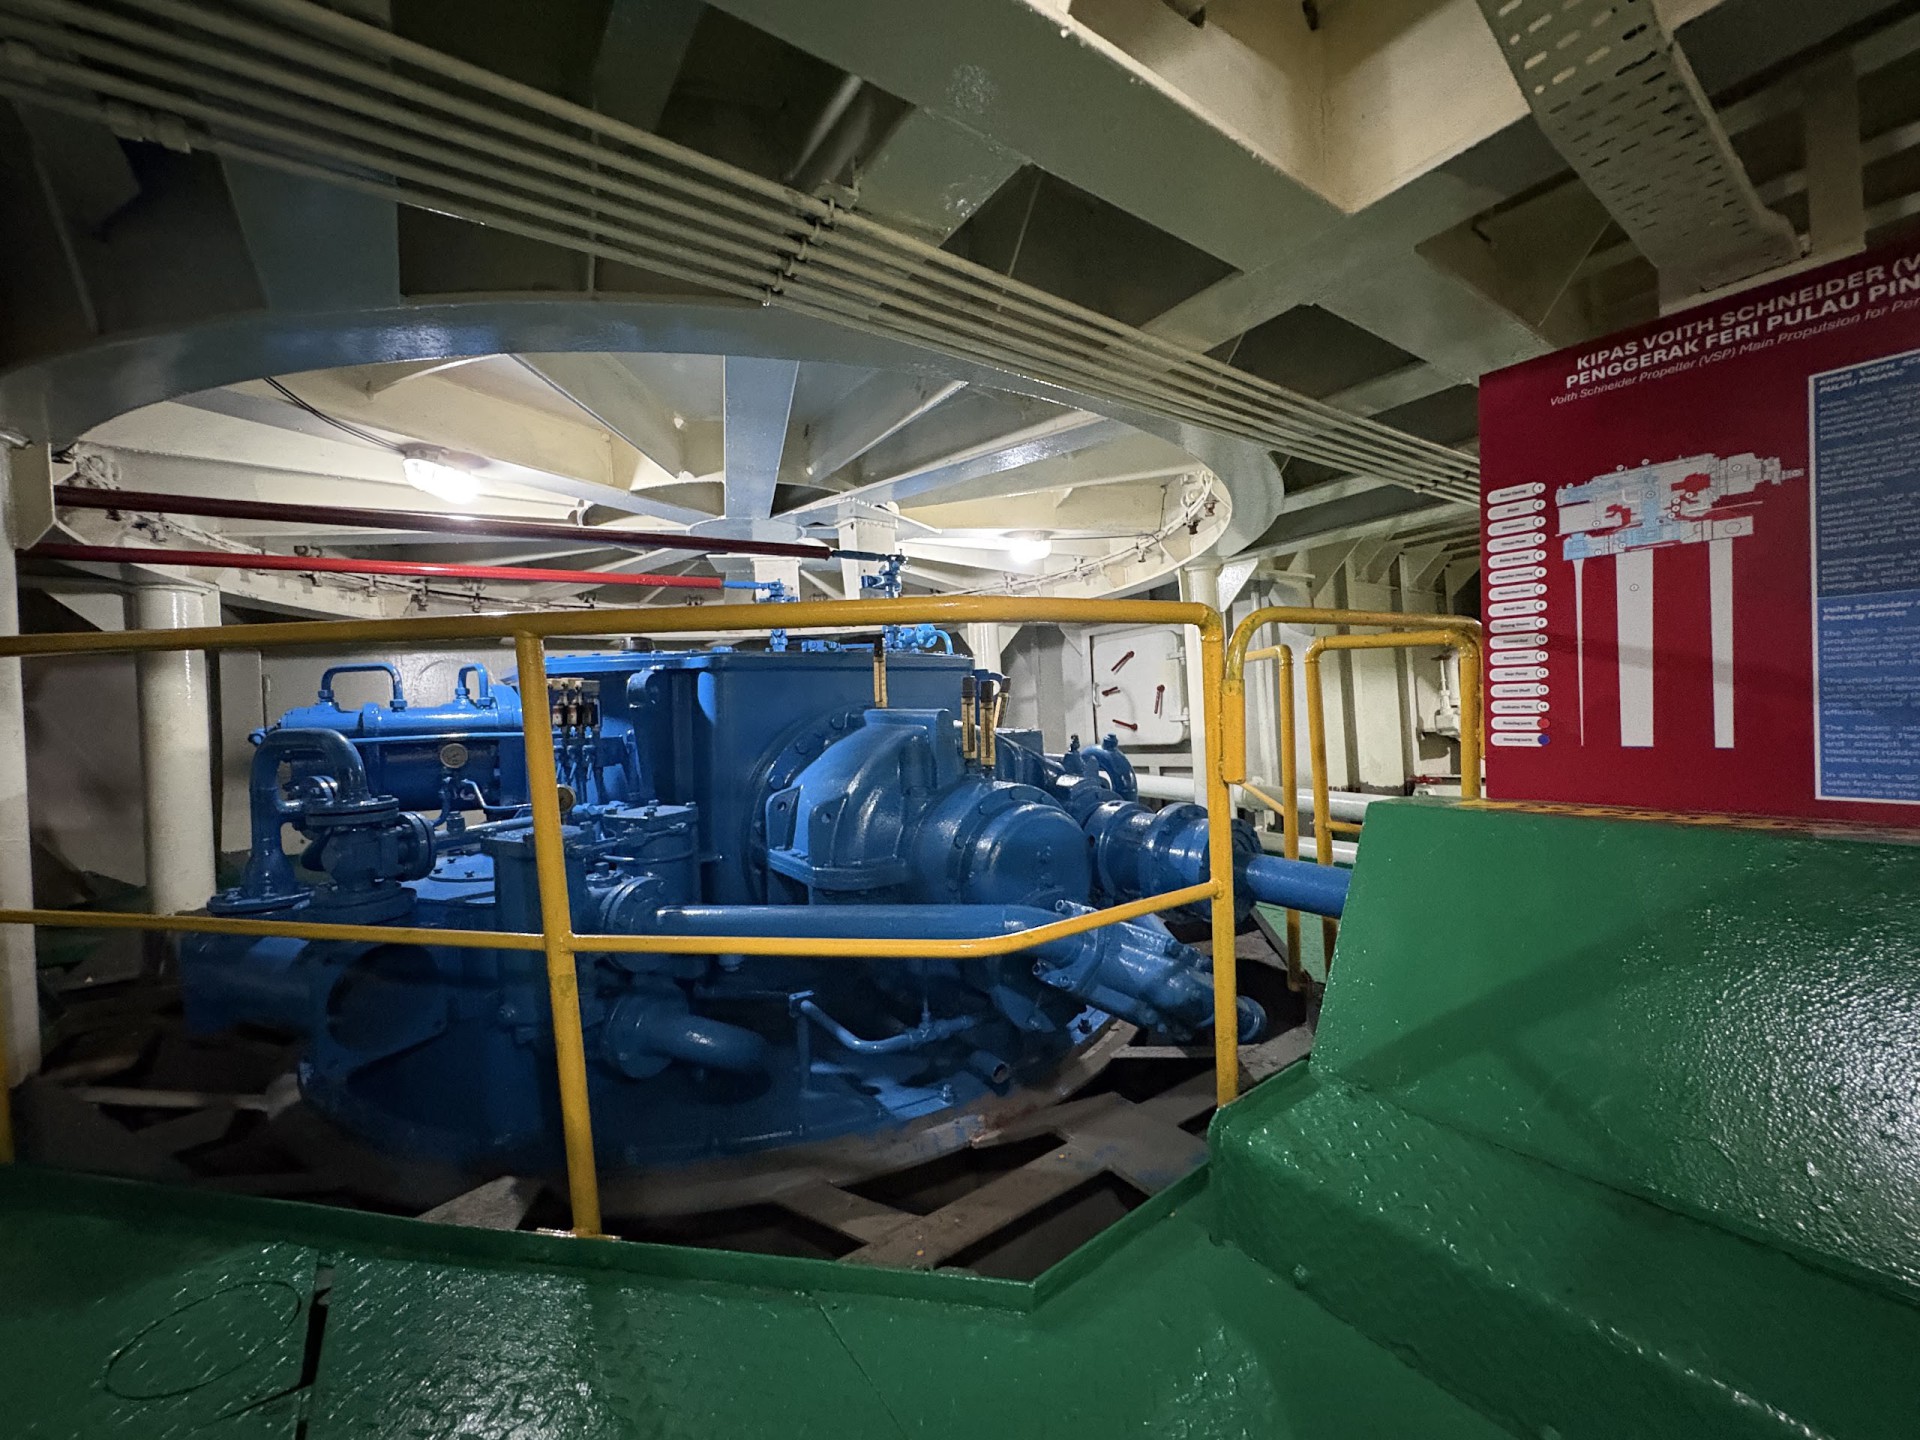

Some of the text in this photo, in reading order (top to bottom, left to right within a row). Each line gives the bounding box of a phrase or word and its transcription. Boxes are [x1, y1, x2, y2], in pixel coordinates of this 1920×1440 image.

[1550, 392, 1577, 406] Voith
[1579, 375, 1636, 398] Schneider
[1639, 361, 1695, 383] Propeller
[1698, 347, 1736, 367] (VSP)
[1739, 337, 1774, 355] Main
[1865, 306, 1888, 321] for
[1566, 339, 1699, 389] PENGGERAK
[1705, 321, 1759, 349] FERI
[1767, 291, 1860, 332] PULAU
[1577, 341, 1639, 370] KIPAS
[1643, 317, 1714, 350] VOITH
[1720, 265, 1885, 327] SCHNEIDER
[1820, 380, 1857, 393] PULAU
